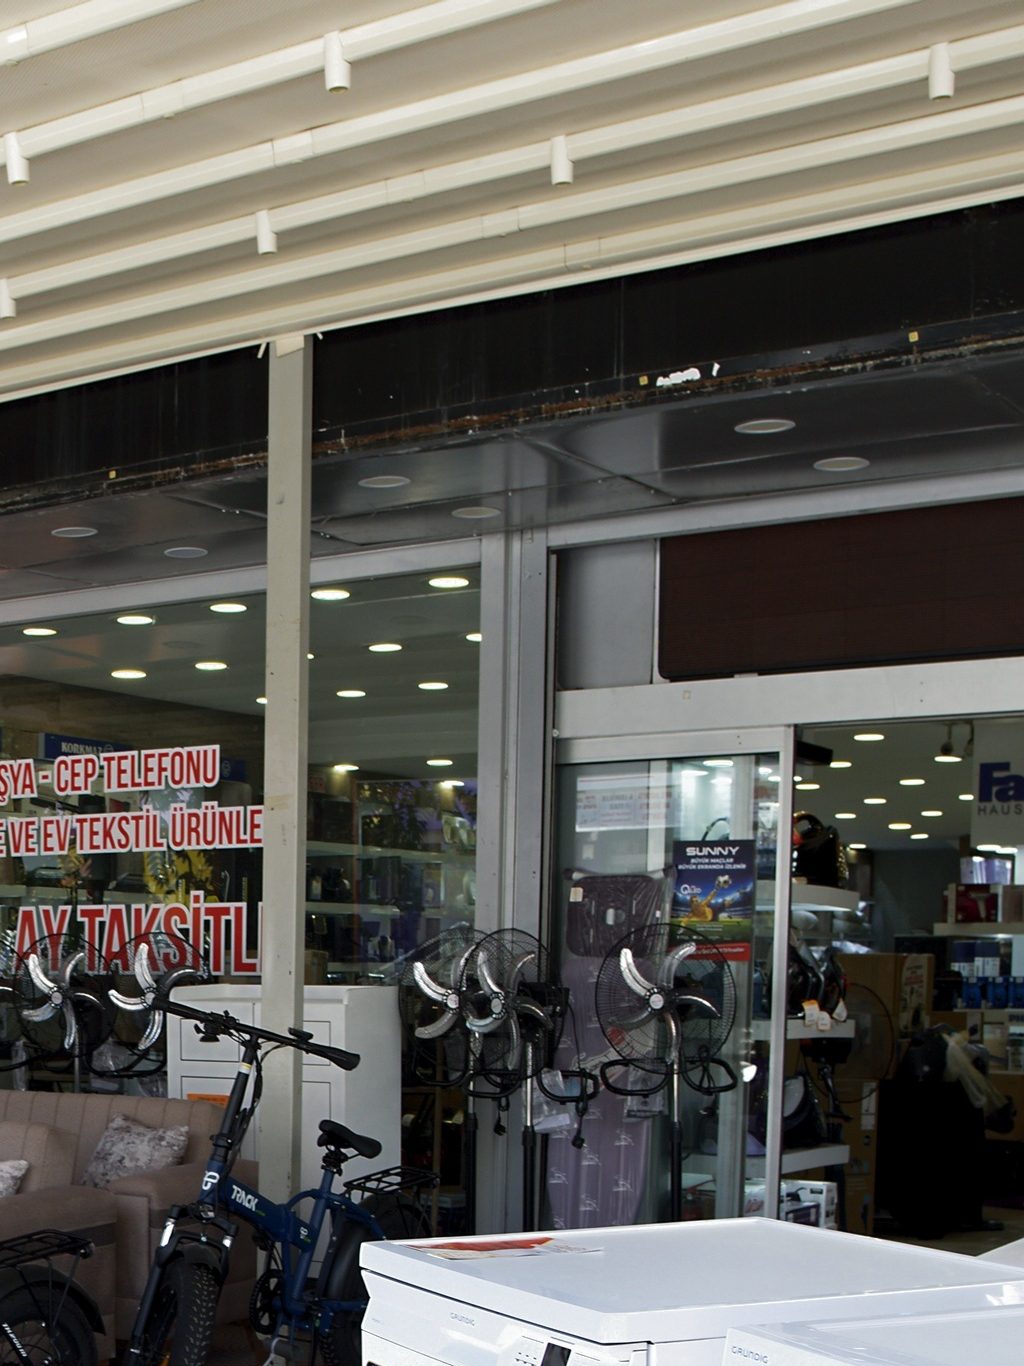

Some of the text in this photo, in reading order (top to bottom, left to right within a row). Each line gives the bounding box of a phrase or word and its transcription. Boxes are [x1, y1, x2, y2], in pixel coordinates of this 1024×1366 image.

[55, 755, 98, 795] CEP
[103, 747, 218, 791] TELEFONU
[10, 820, 37, 854] VE
[43, 818, 70, 853] EV
[76, 808, 164, 851] TEKSTİL
[686, 847, 739, 856] SUNNY
[15, 907, 71, 974] AY
[79, 892, 263, 975] TAKSİTL
[231, 1184, 259, 1211] TRACK
[731, 1346, 769, 1364] GRUNDIG
